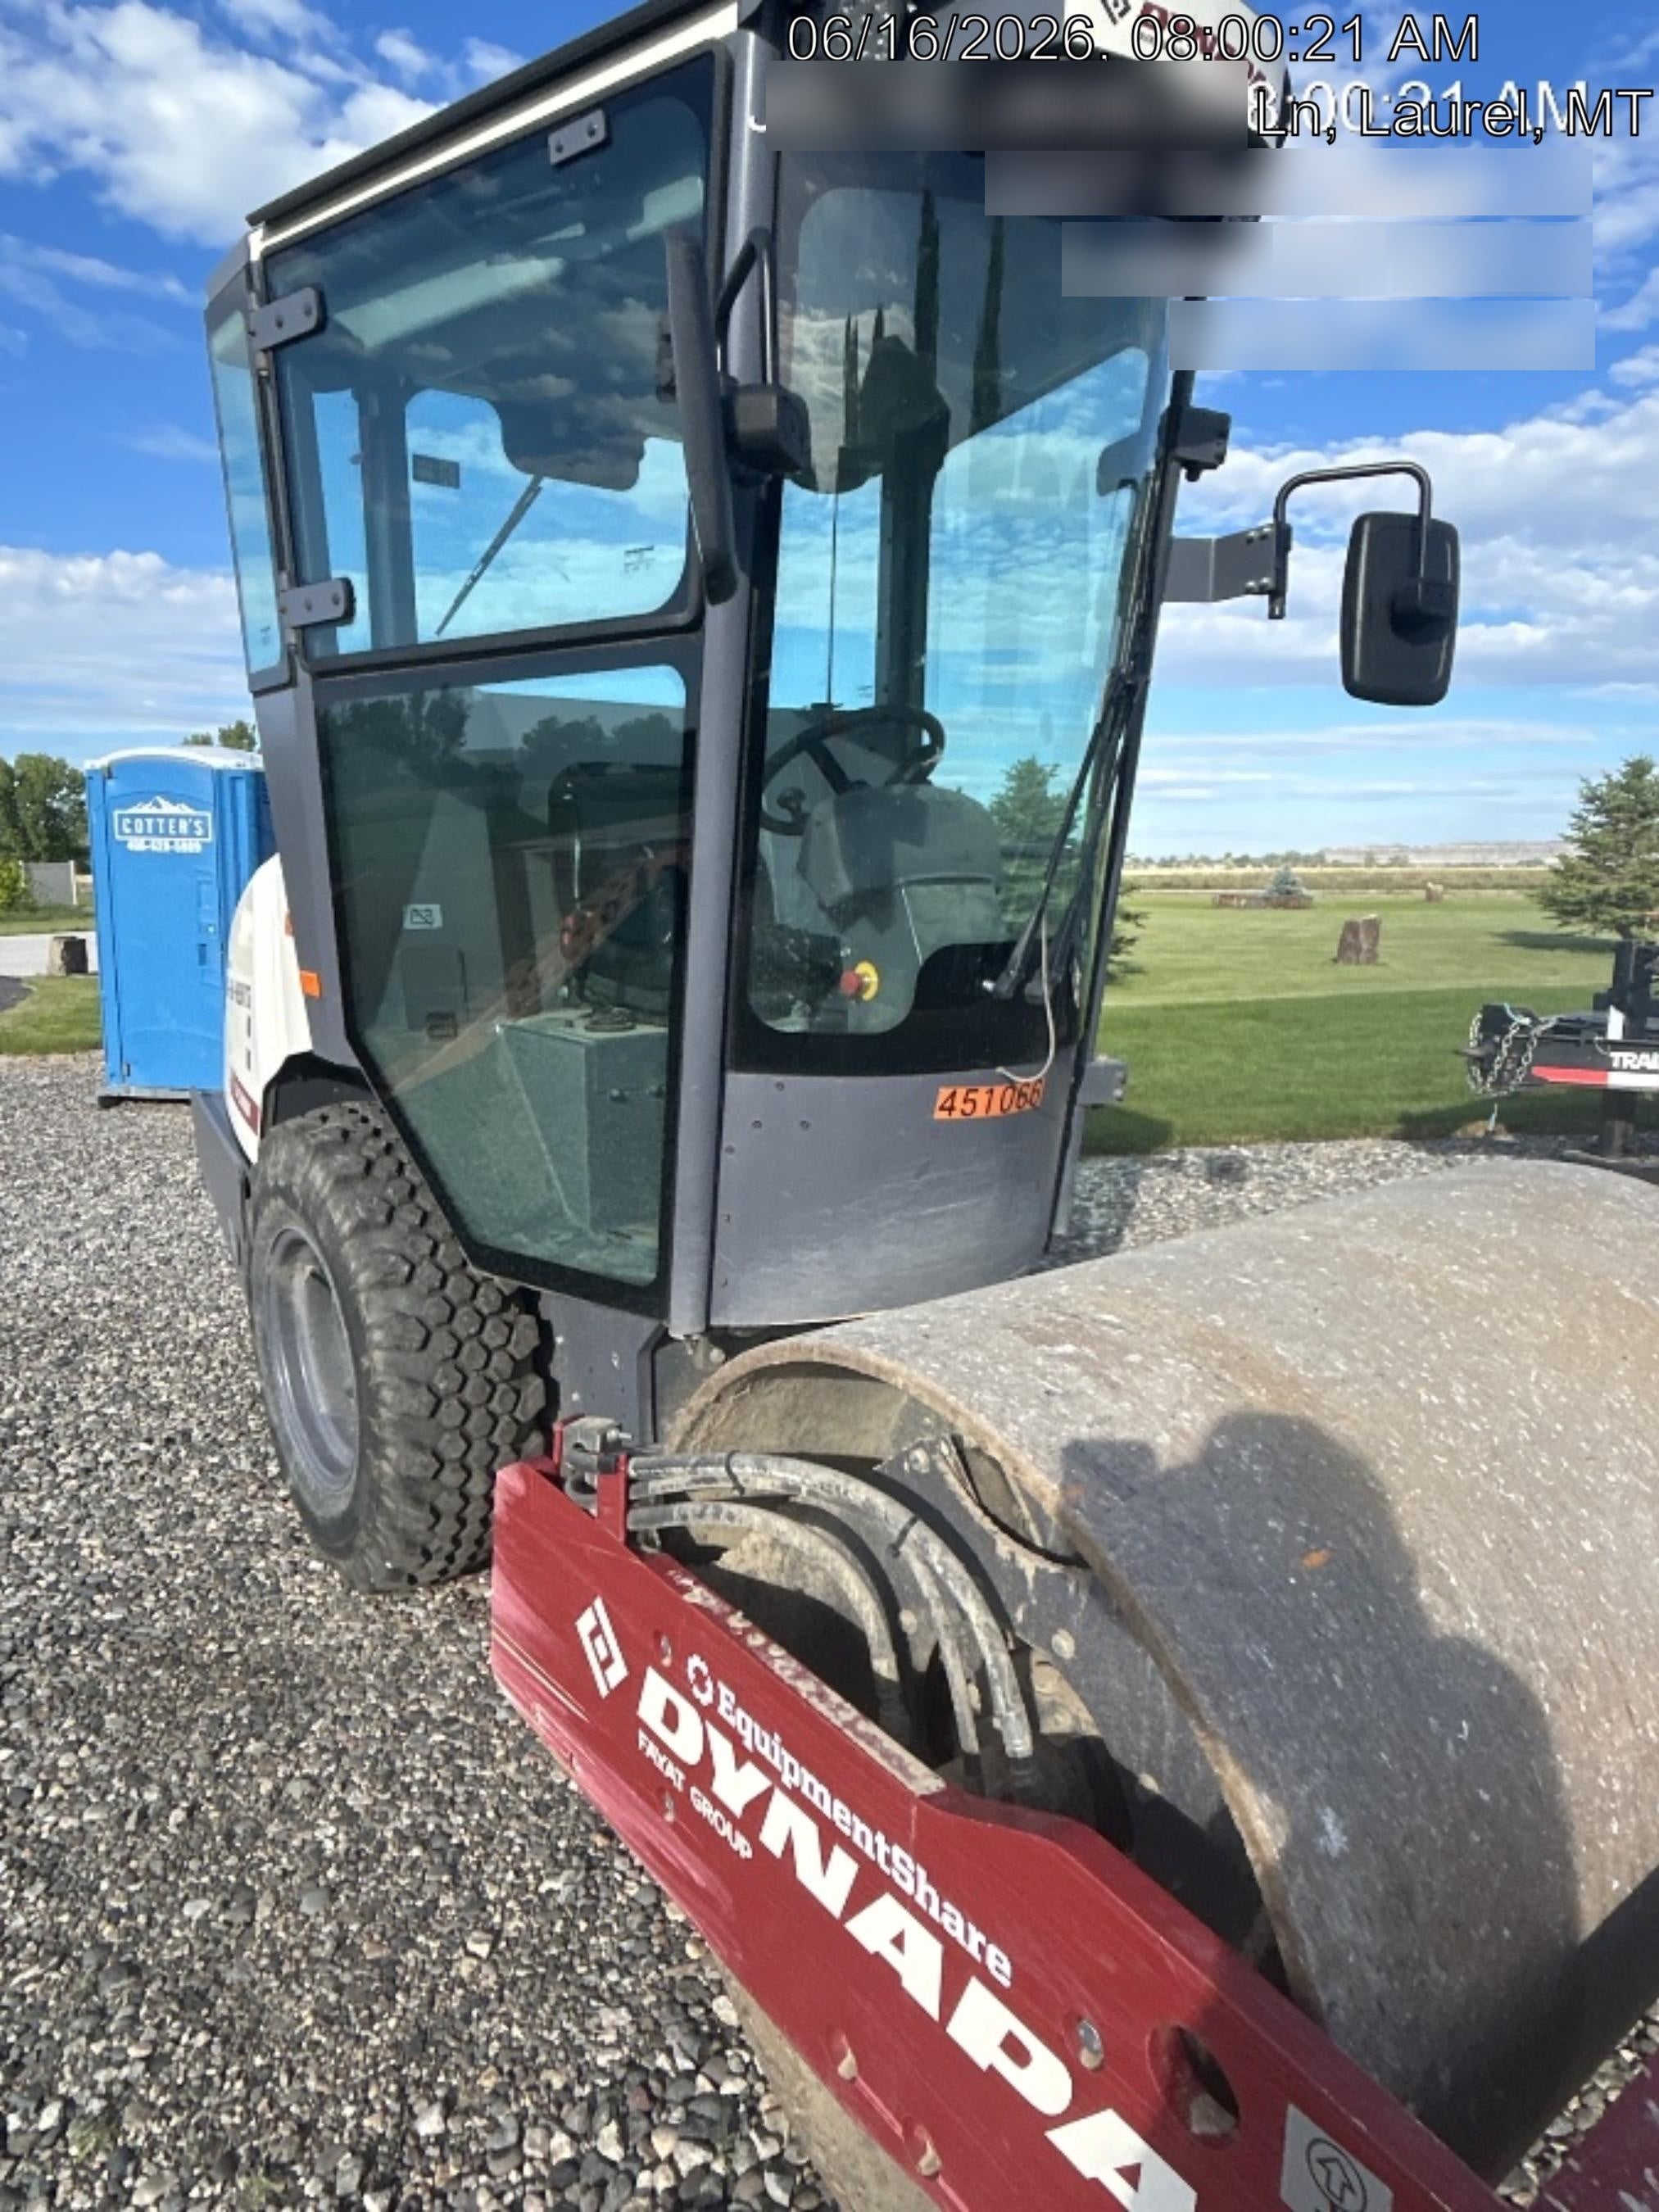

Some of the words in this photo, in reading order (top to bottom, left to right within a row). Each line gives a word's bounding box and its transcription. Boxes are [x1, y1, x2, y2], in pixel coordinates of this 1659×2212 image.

[121, 817, 205, 836] COTTER'S
[937, 1078, 1044, 1117] 451066
[637, 1729, 687, 1793] FAYAT
[689, 1786, 753, 1861] GROUP
[716, 1679, 1013, 1988] EquipmentShare
